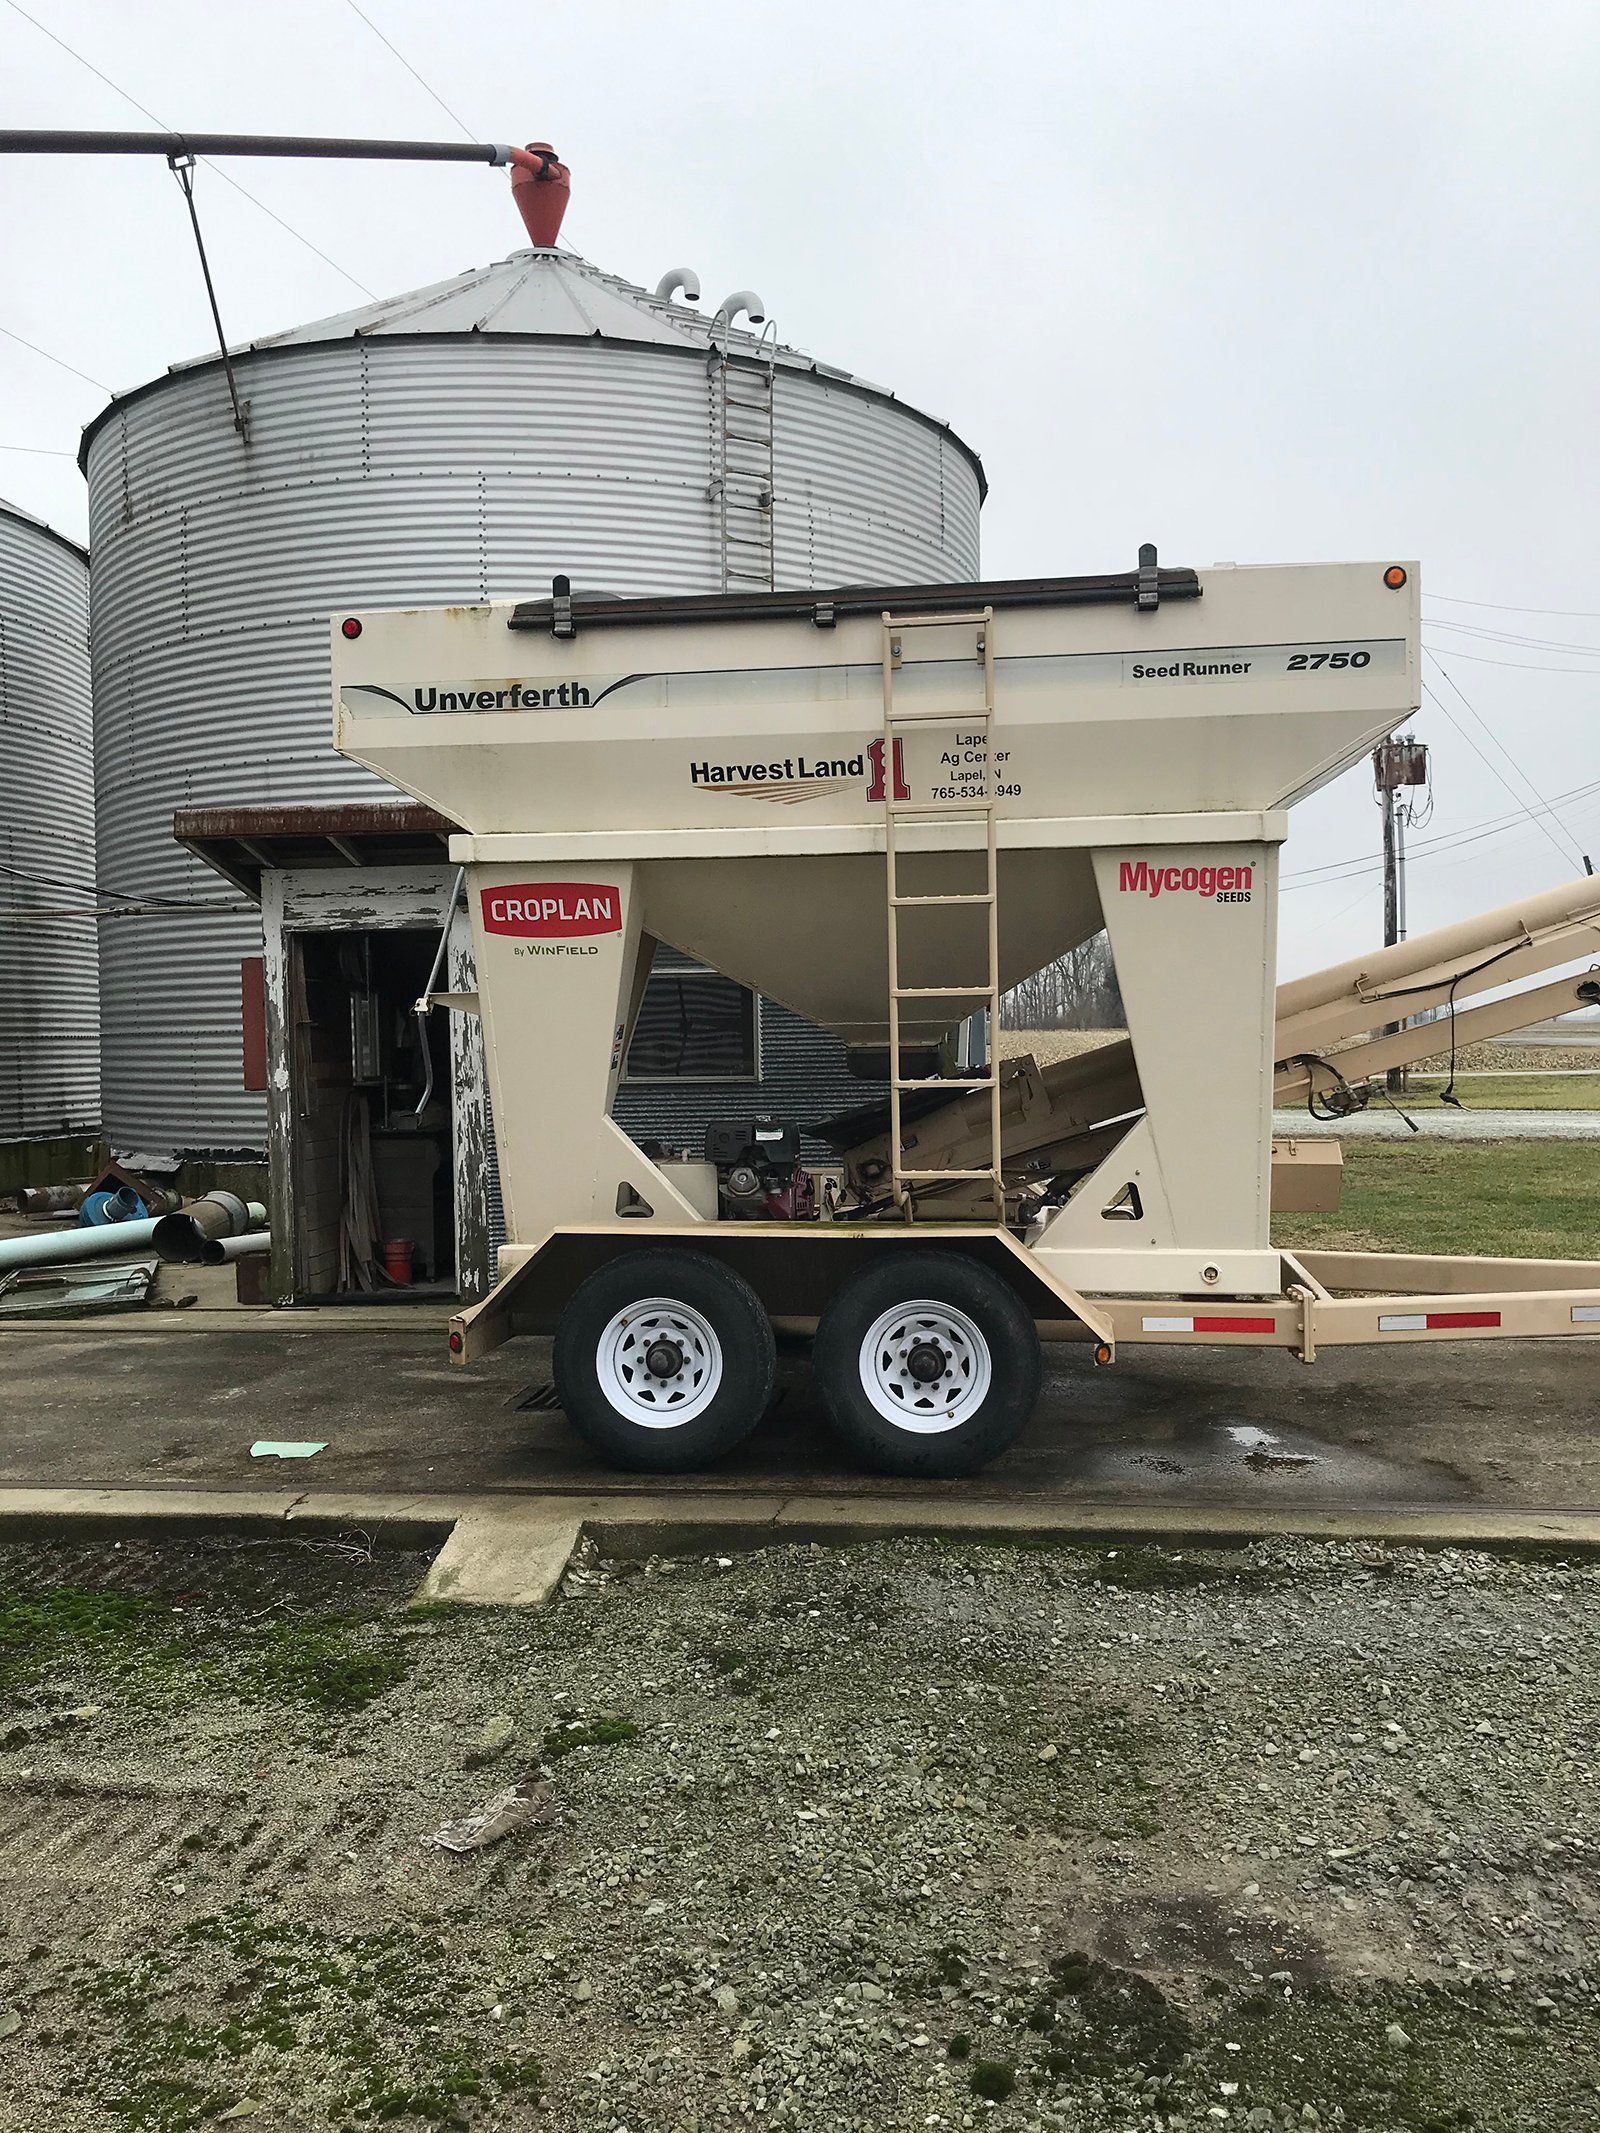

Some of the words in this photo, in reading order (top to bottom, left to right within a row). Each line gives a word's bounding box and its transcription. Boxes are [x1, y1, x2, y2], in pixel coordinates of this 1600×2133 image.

[1286, 651, 1371, 671] 2750
[414, 682, 591, 712] Unverferth
[955, 734, 988, 748] Lape
[940, 752, 960, 766] Ag
[950, 769, 986, 782] Lapel,
[931, 784, 1022, 799] 765-534-949
[1119, 861, 1253, 898] Mycogen
[1216, 892, 1252, 903] SEEDS
[490, 897, 612, 922] CROPLAN
[514, 947, 525, 957] By
